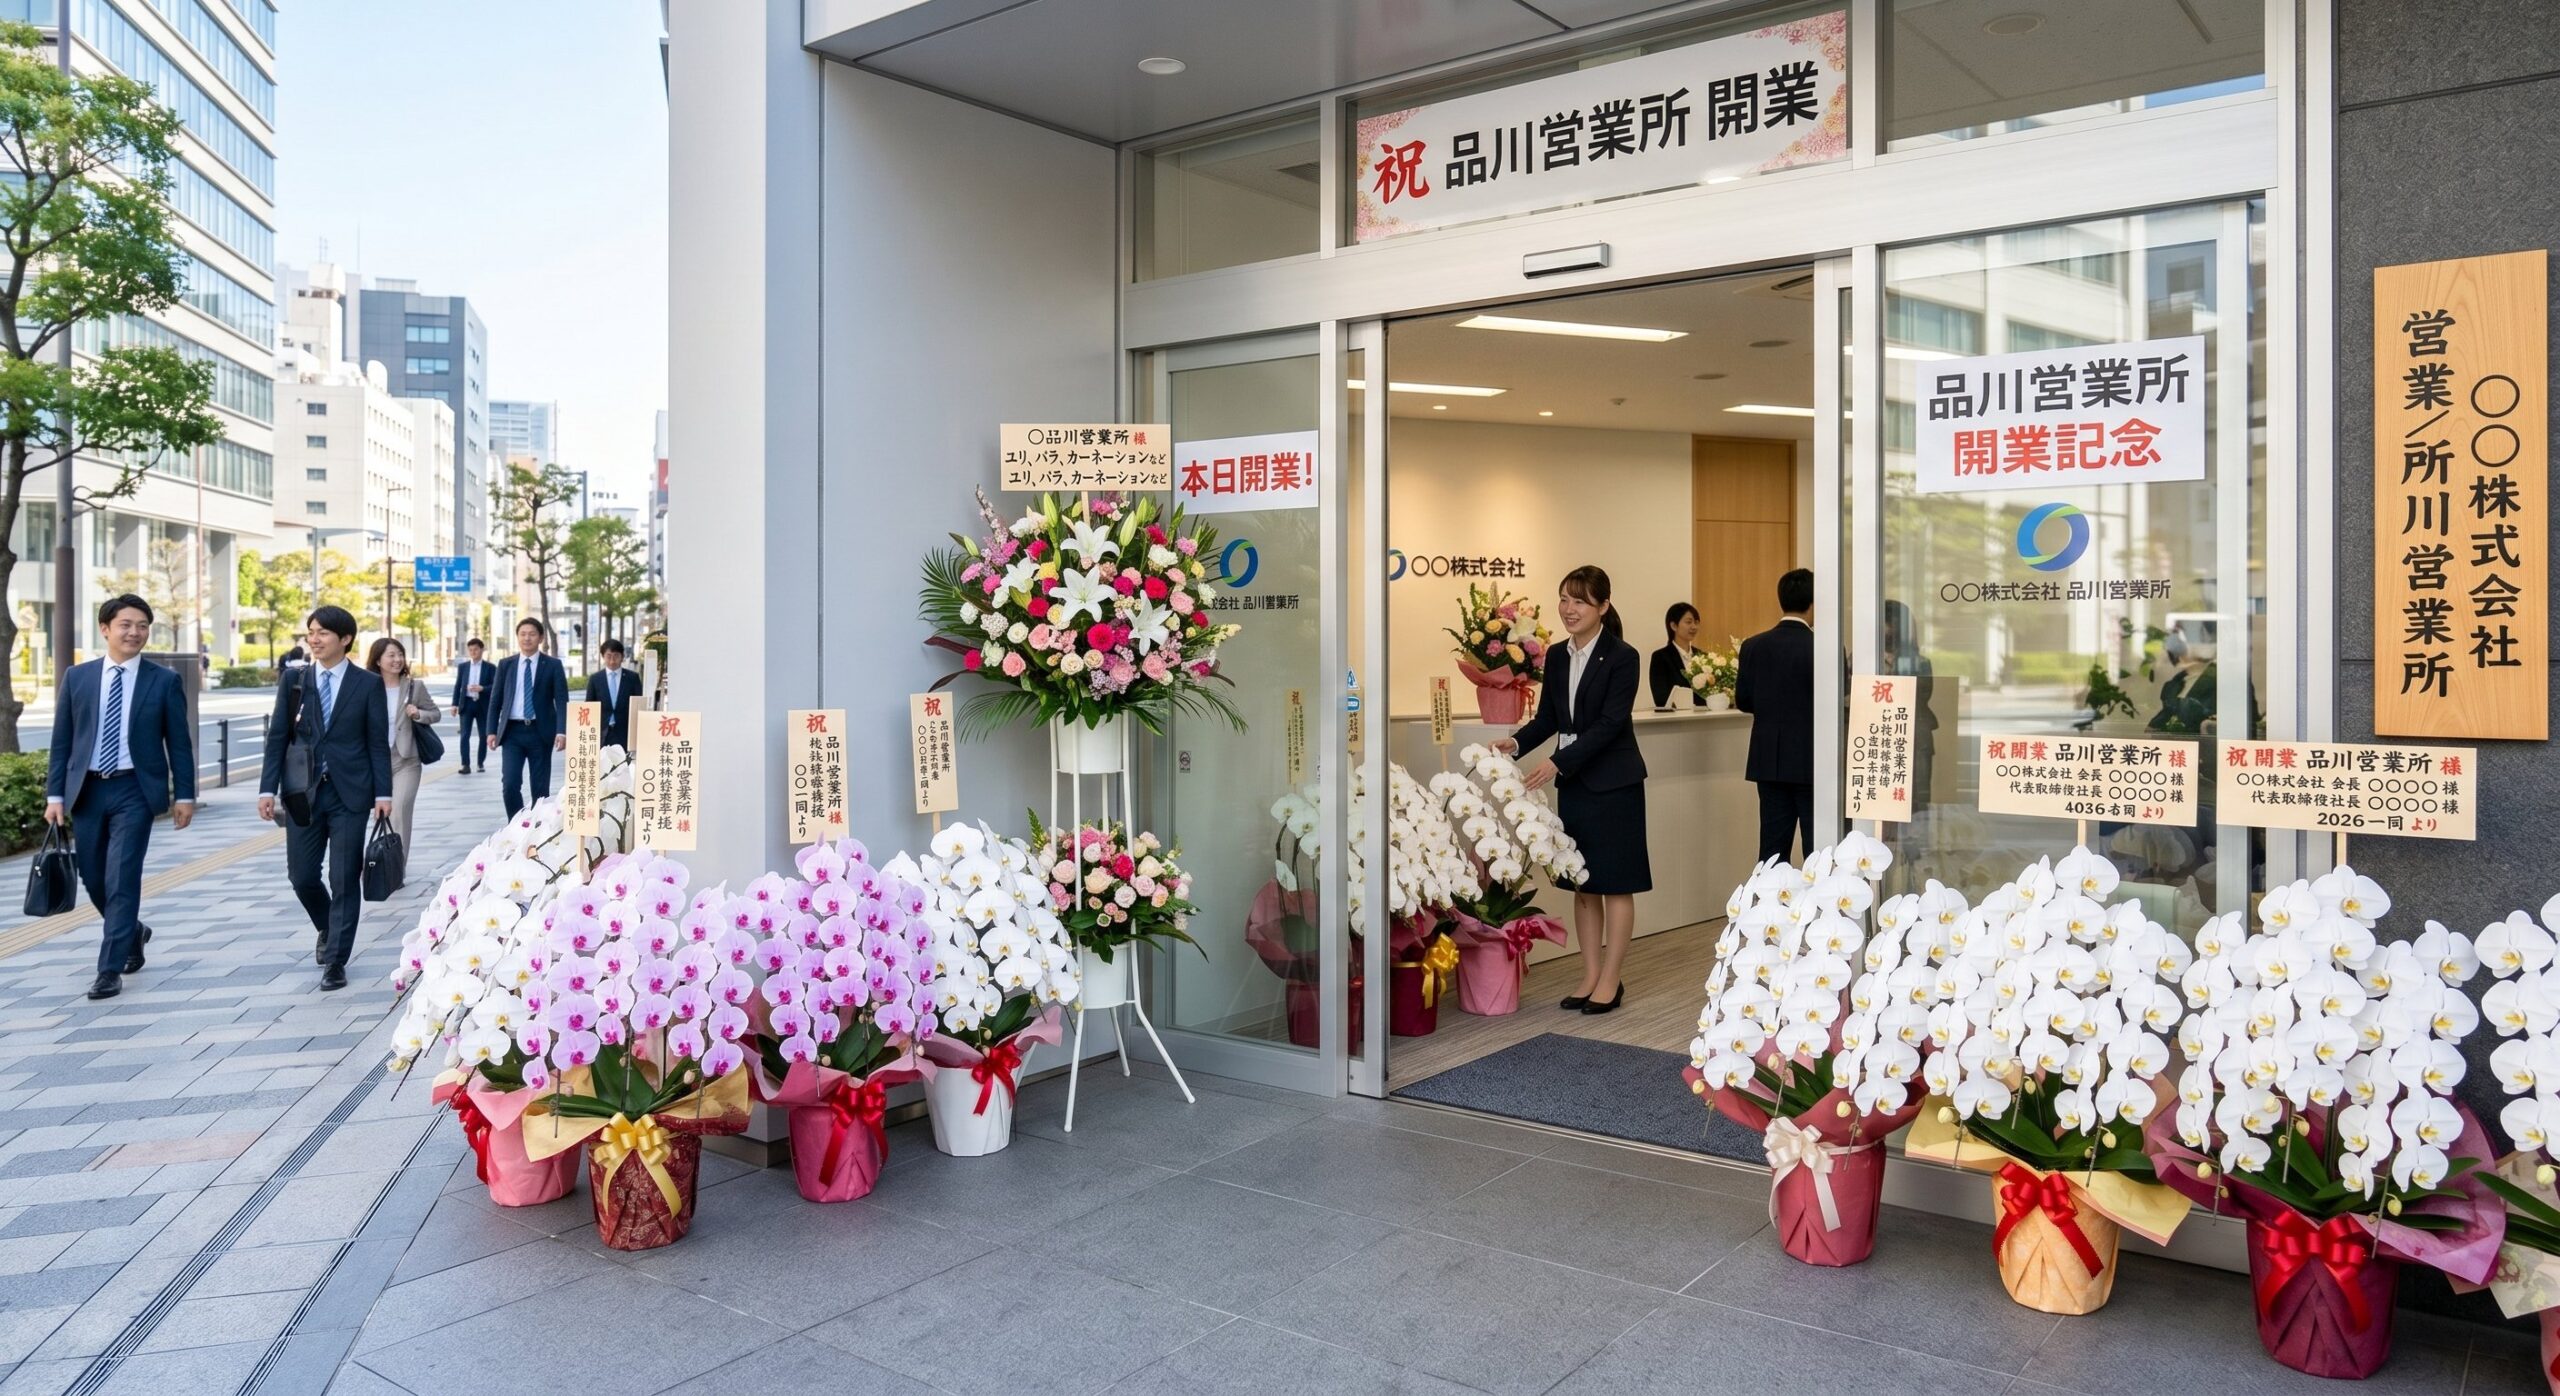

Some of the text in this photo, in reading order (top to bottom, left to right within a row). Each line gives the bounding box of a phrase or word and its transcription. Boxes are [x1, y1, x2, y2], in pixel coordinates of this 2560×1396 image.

[1373, 60, 1819, 205] 祝 品川営業所 開業
[1929, 354, 2190, 420] 品川営業所
[1954, 418, 2162, 476] 開業記念
[2067, 579, 2171, 600] 品川営業所
[1243, 594, 1299, 610] 品川営業所
[1872, 681, 1894, 703] 祝
[577, 707, 591, 726] 祝
[924, 697, 942, 716] 祝
[658, 715, 681, 737] 祝
[806, 714, 827, 733] 祝
[2055, 743, 2162, 766] 品川営業所
[2168, 749, 2187, 768] 様
[2306, 749, 2433, 774] 品川営業所
[2440, 756, 2463, 776] 様
[2078, 768, 2102, 782] 会長
[2331, 776, 2361, 791] 会長
[2142, 806, 2164, 819] より
[2410, 817, 2437, 831] より
